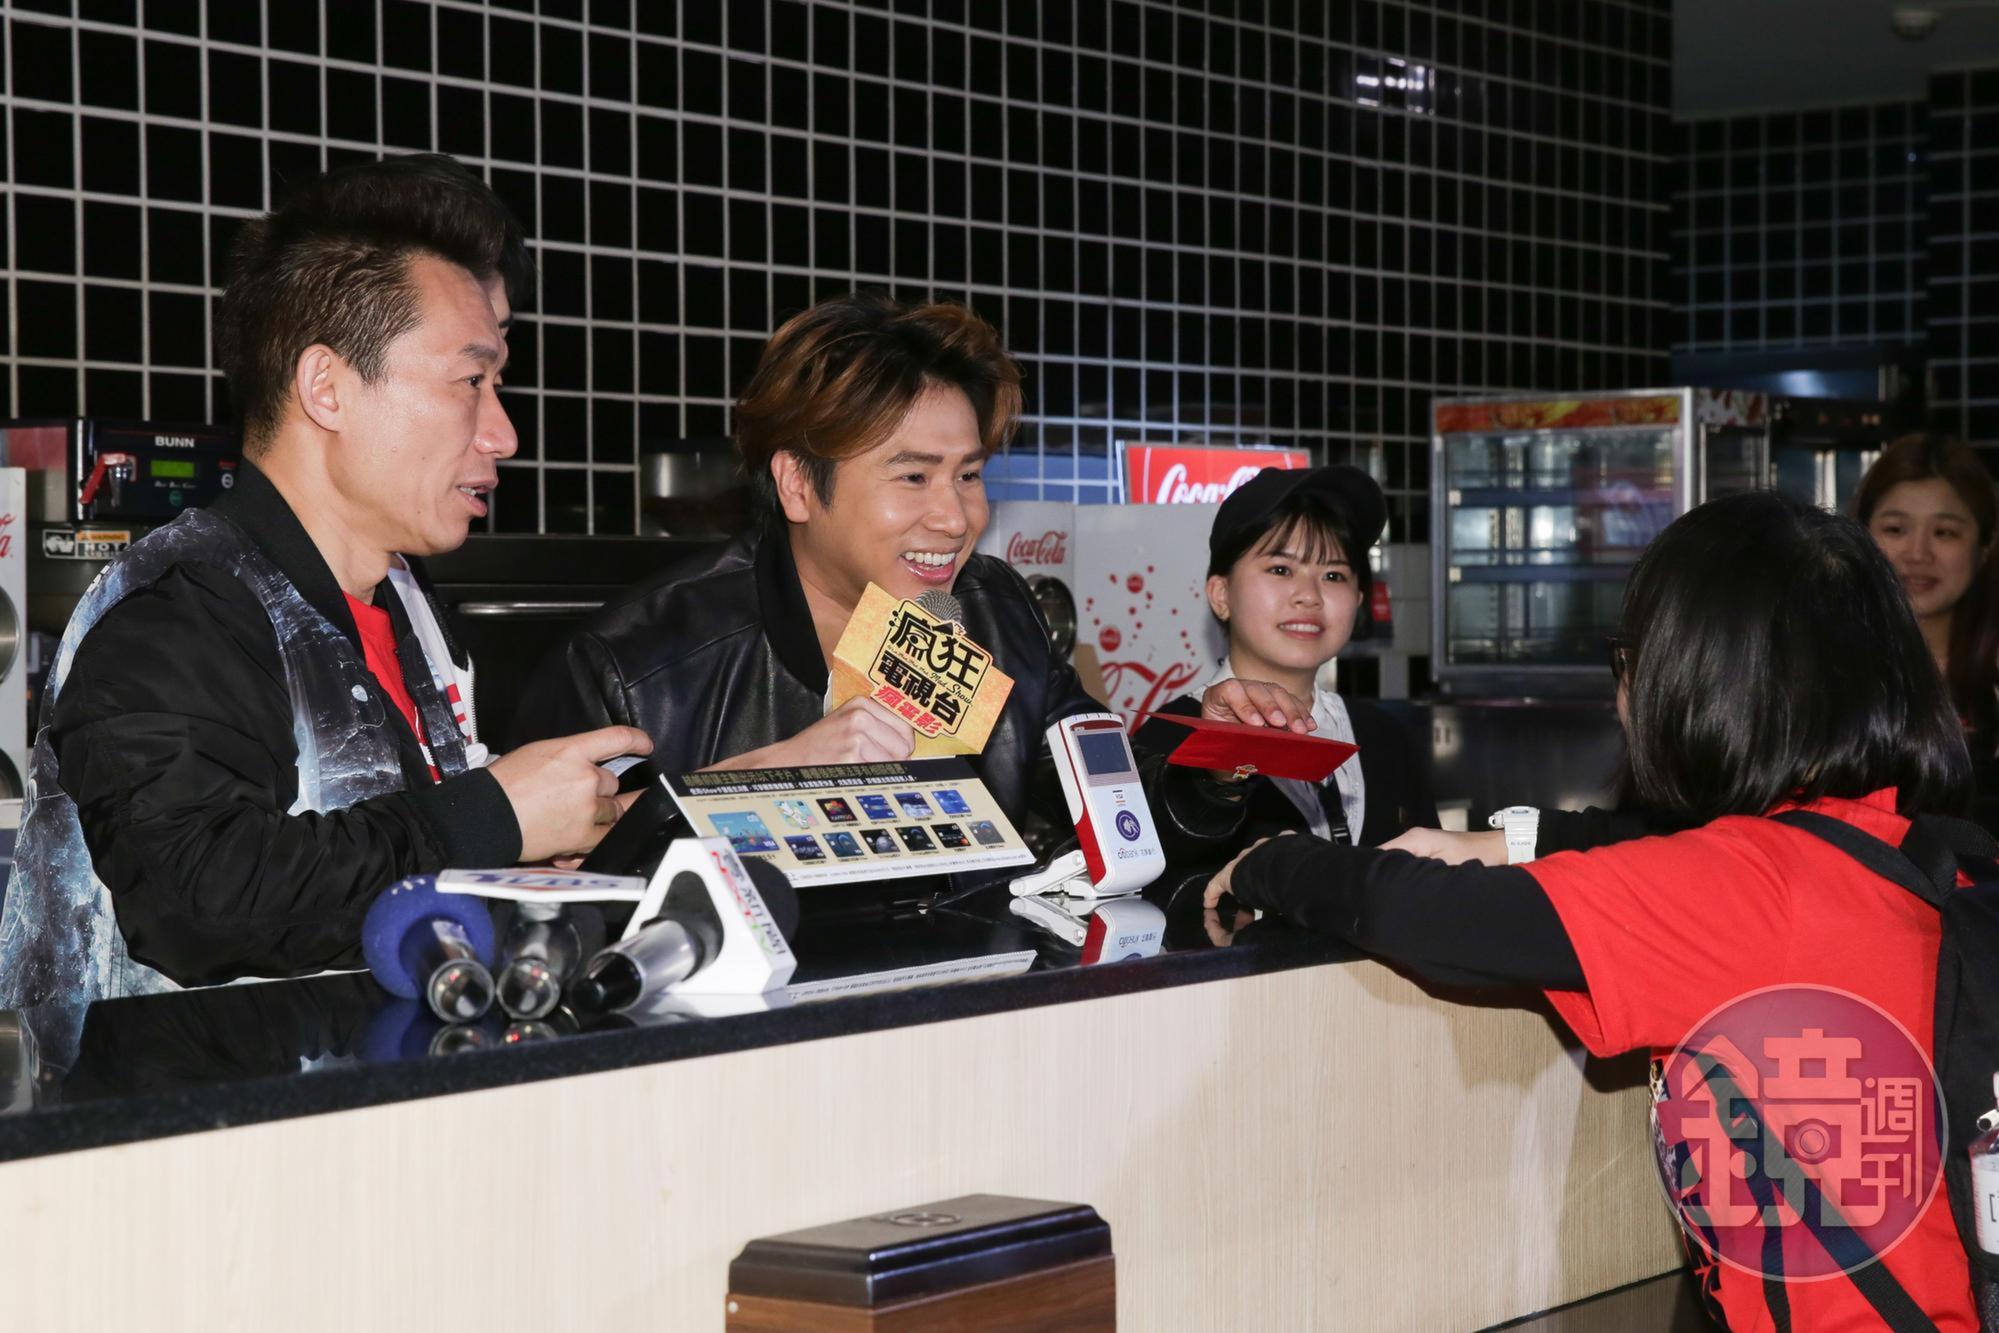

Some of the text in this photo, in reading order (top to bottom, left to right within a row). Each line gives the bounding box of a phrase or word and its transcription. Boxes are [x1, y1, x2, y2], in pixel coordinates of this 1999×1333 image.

[155, 436, 195, 448] BUNN
[1006, 530, 1068, 568] Coca-Cola
[889, 610, 984, 691] 瘋狂
[877, 650, 961, 727] 電視台
[946, 683, 974, 706] Show
